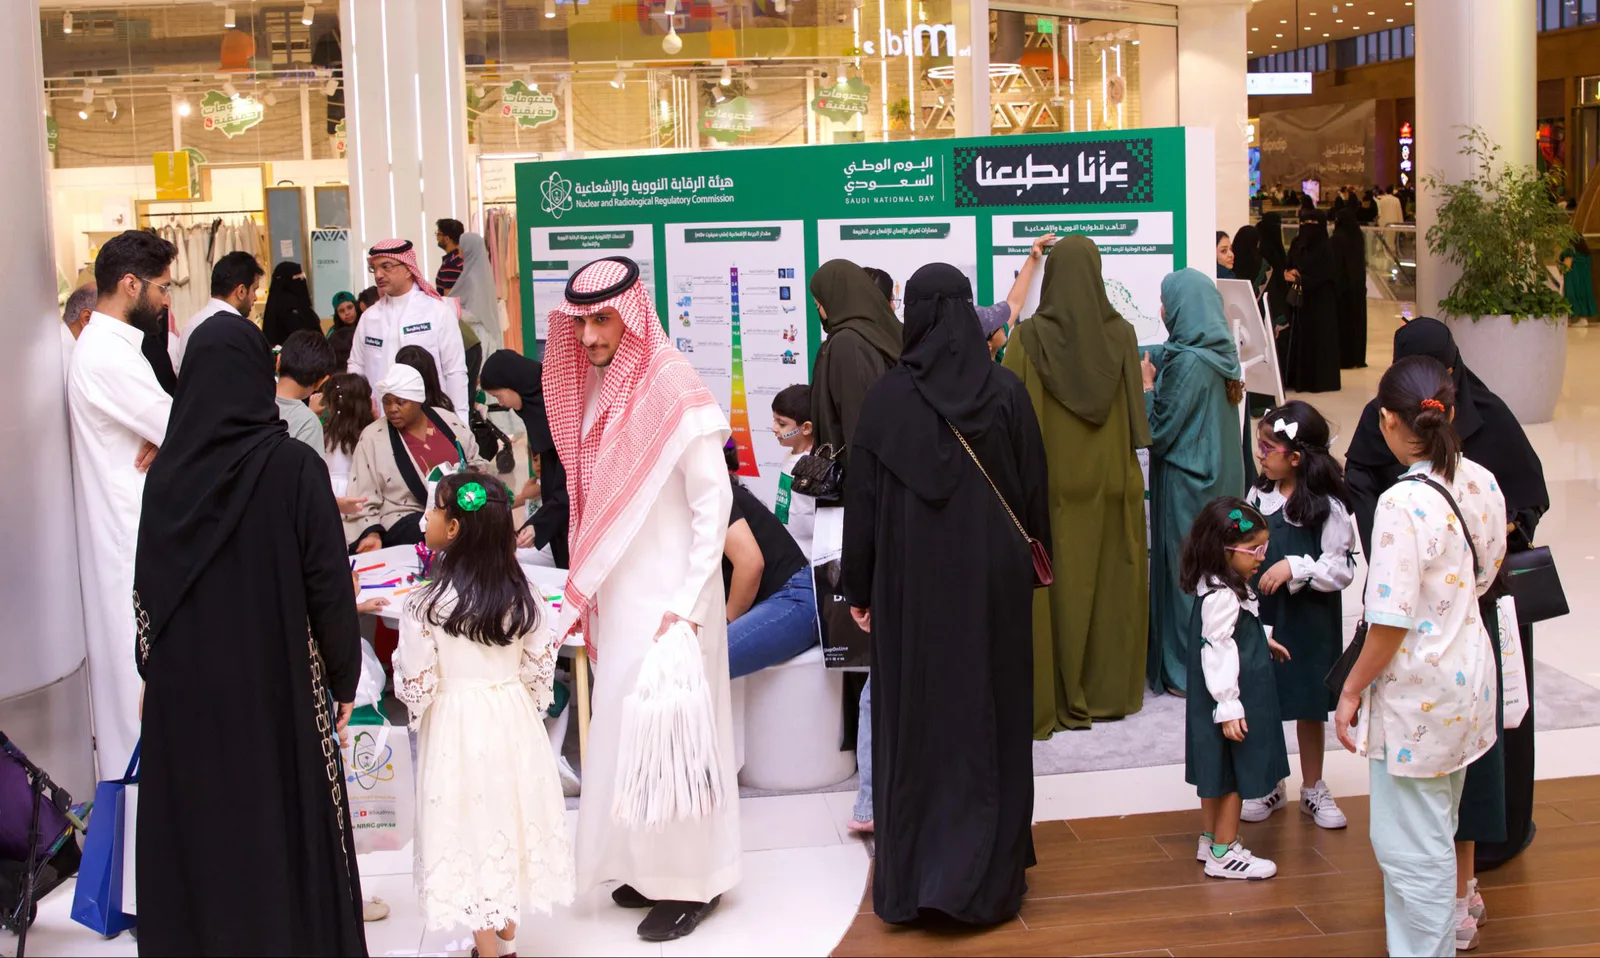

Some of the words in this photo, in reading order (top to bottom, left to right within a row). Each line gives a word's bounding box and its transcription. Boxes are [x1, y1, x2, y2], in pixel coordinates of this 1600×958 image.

[819, 88, 869, 102] خصومات
[843, 158, 891, 178] الوطني
[894, 156, 933, 173] اليوم
[708, 174, 734, 191] هيئة
[975, 153, 1070, 197] بطبعنا
[575, 179, 629, 197] والإشعاعية
[632, 178, 668, 195] النووية
[671, 176, 705, 193] الرقابة
[844, 174, 934, 195] السعودي
[576, 199, 599, 208] Nuclear
[600, 198, 614, 207] and
[614, 197, 654, 208] Radiological
[654, 195, 690, 206] Regulatory
[692, 194, 735, 204] Commission
[845, 197, 870, 205] SAUDI
[874, 196, 914, 204] NATIONAL
